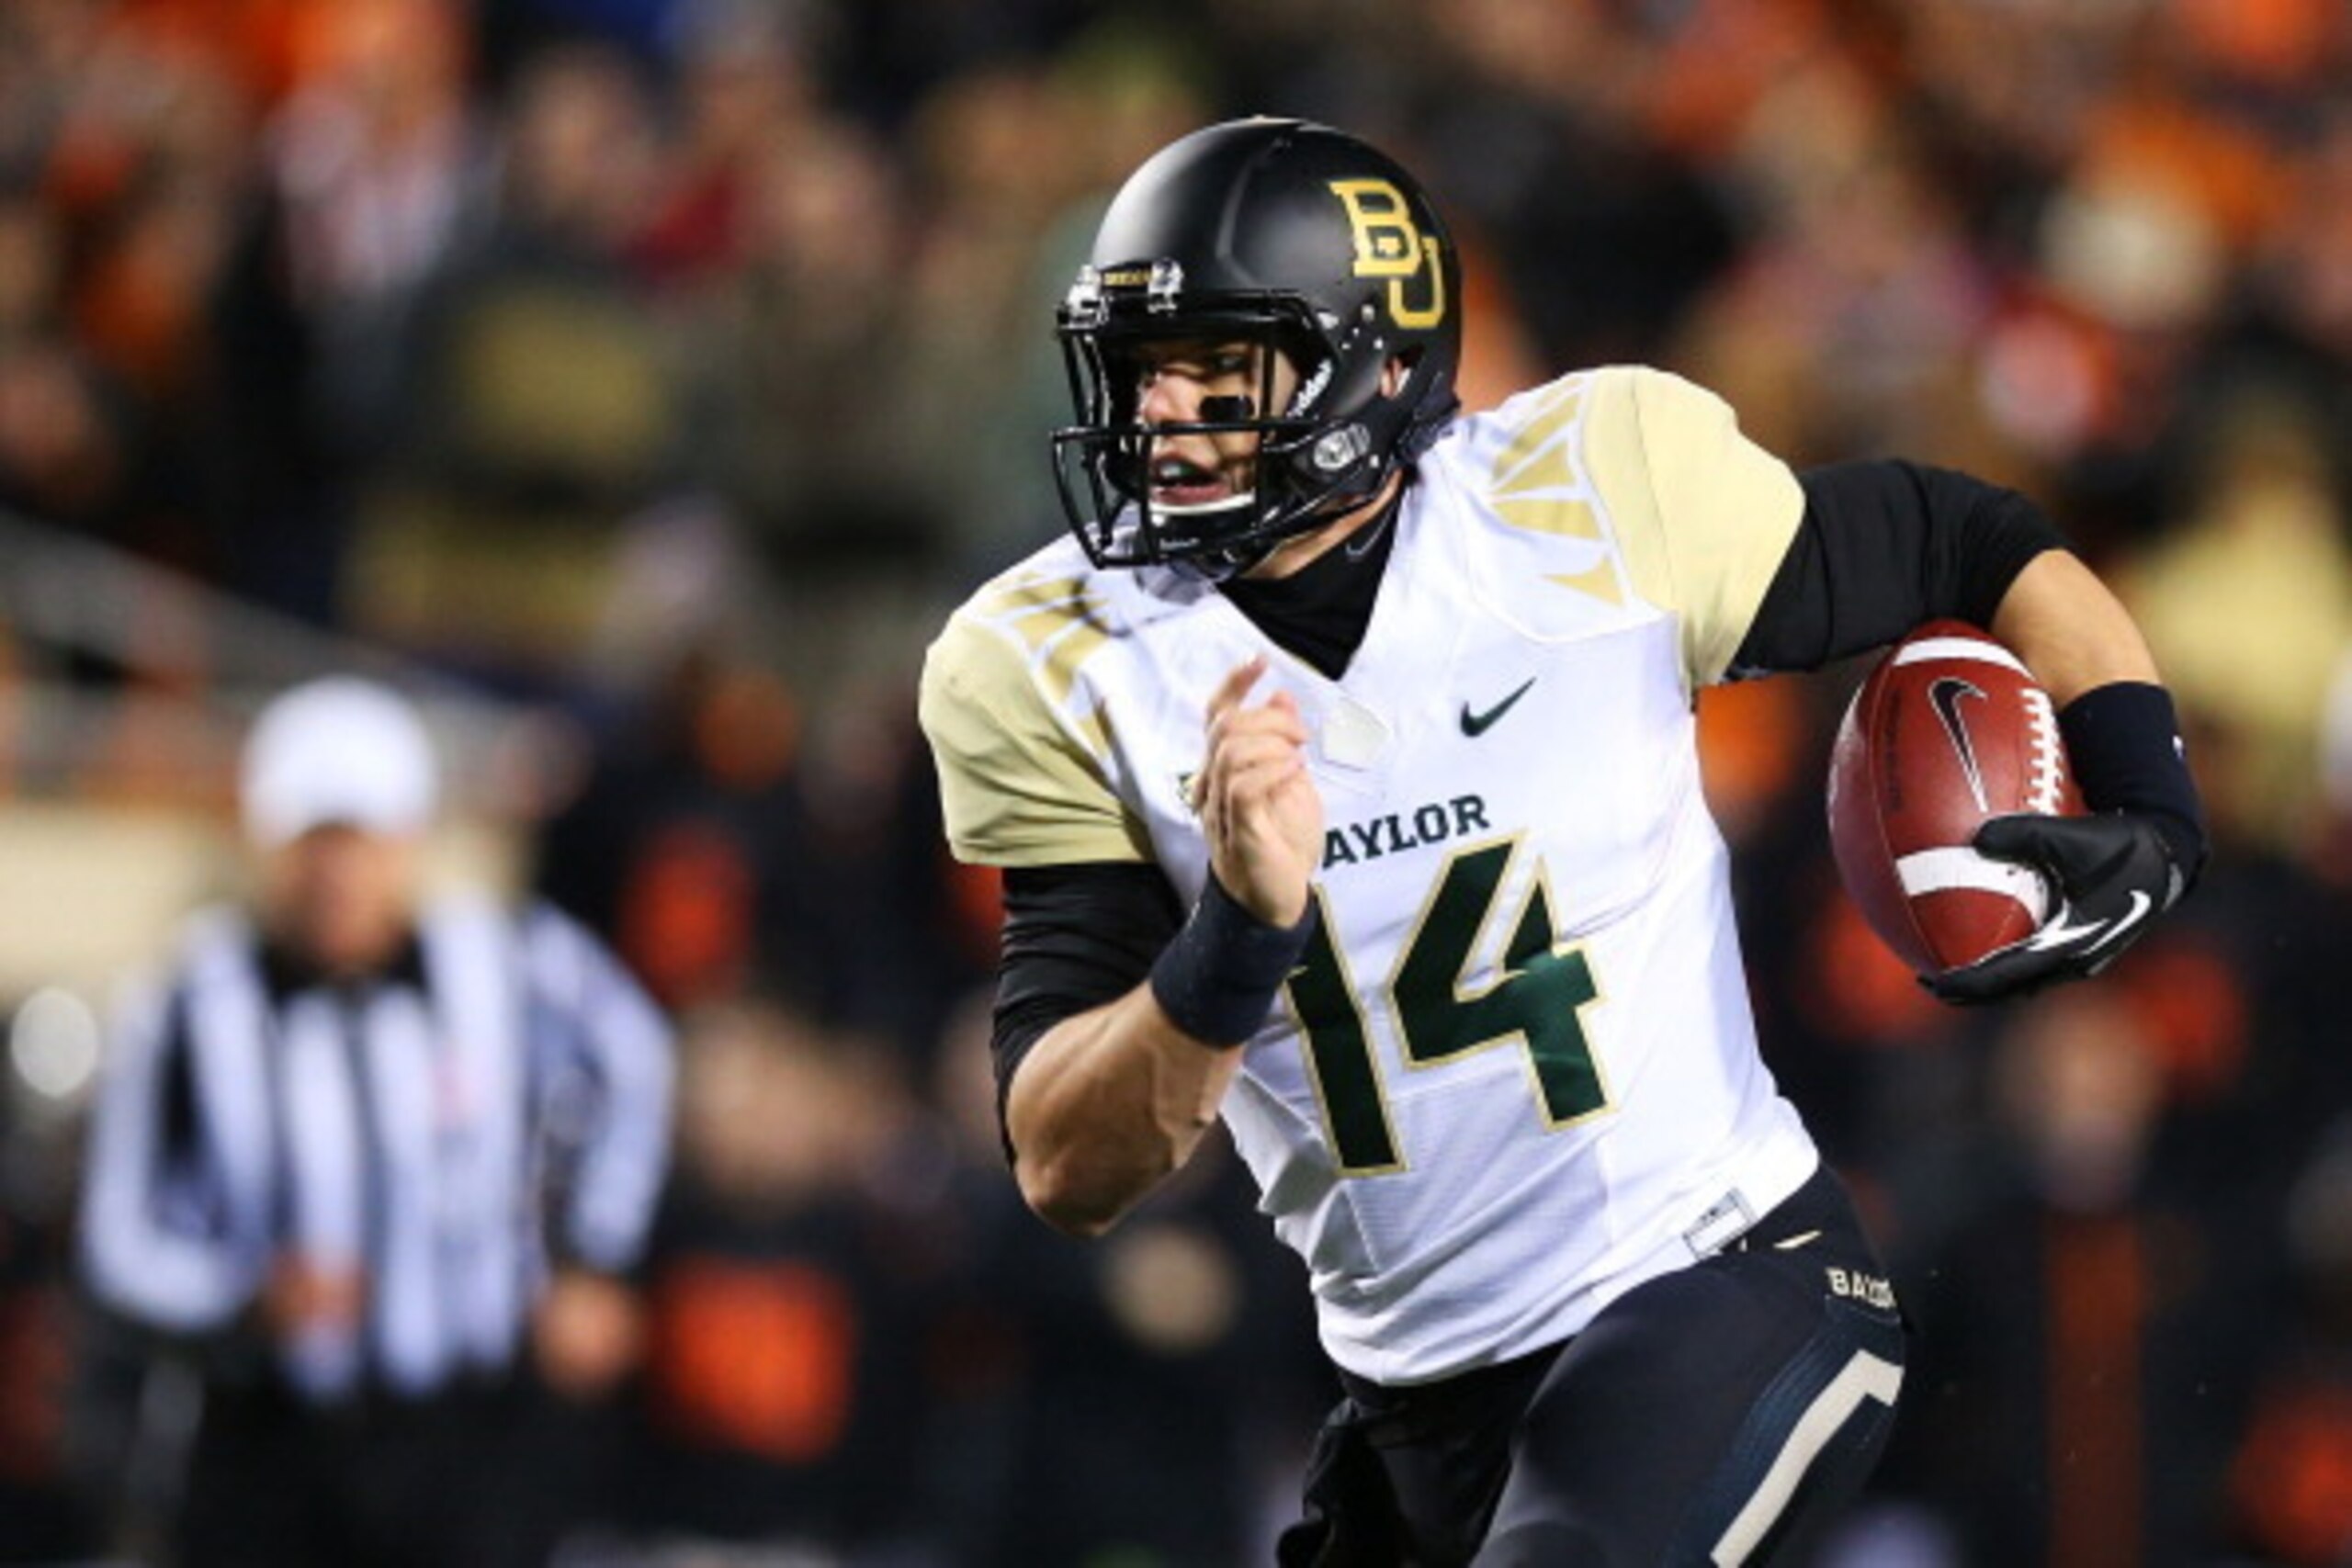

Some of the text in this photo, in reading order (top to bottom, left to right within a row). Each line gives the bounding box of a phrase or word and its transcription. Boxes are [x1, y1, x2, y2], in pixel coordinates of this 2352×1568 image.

[1329, 178, 1445, 329] BU
[1321, 794, 1491, 871] AYLOR
[1286, 830, 1619, 1177] 14
